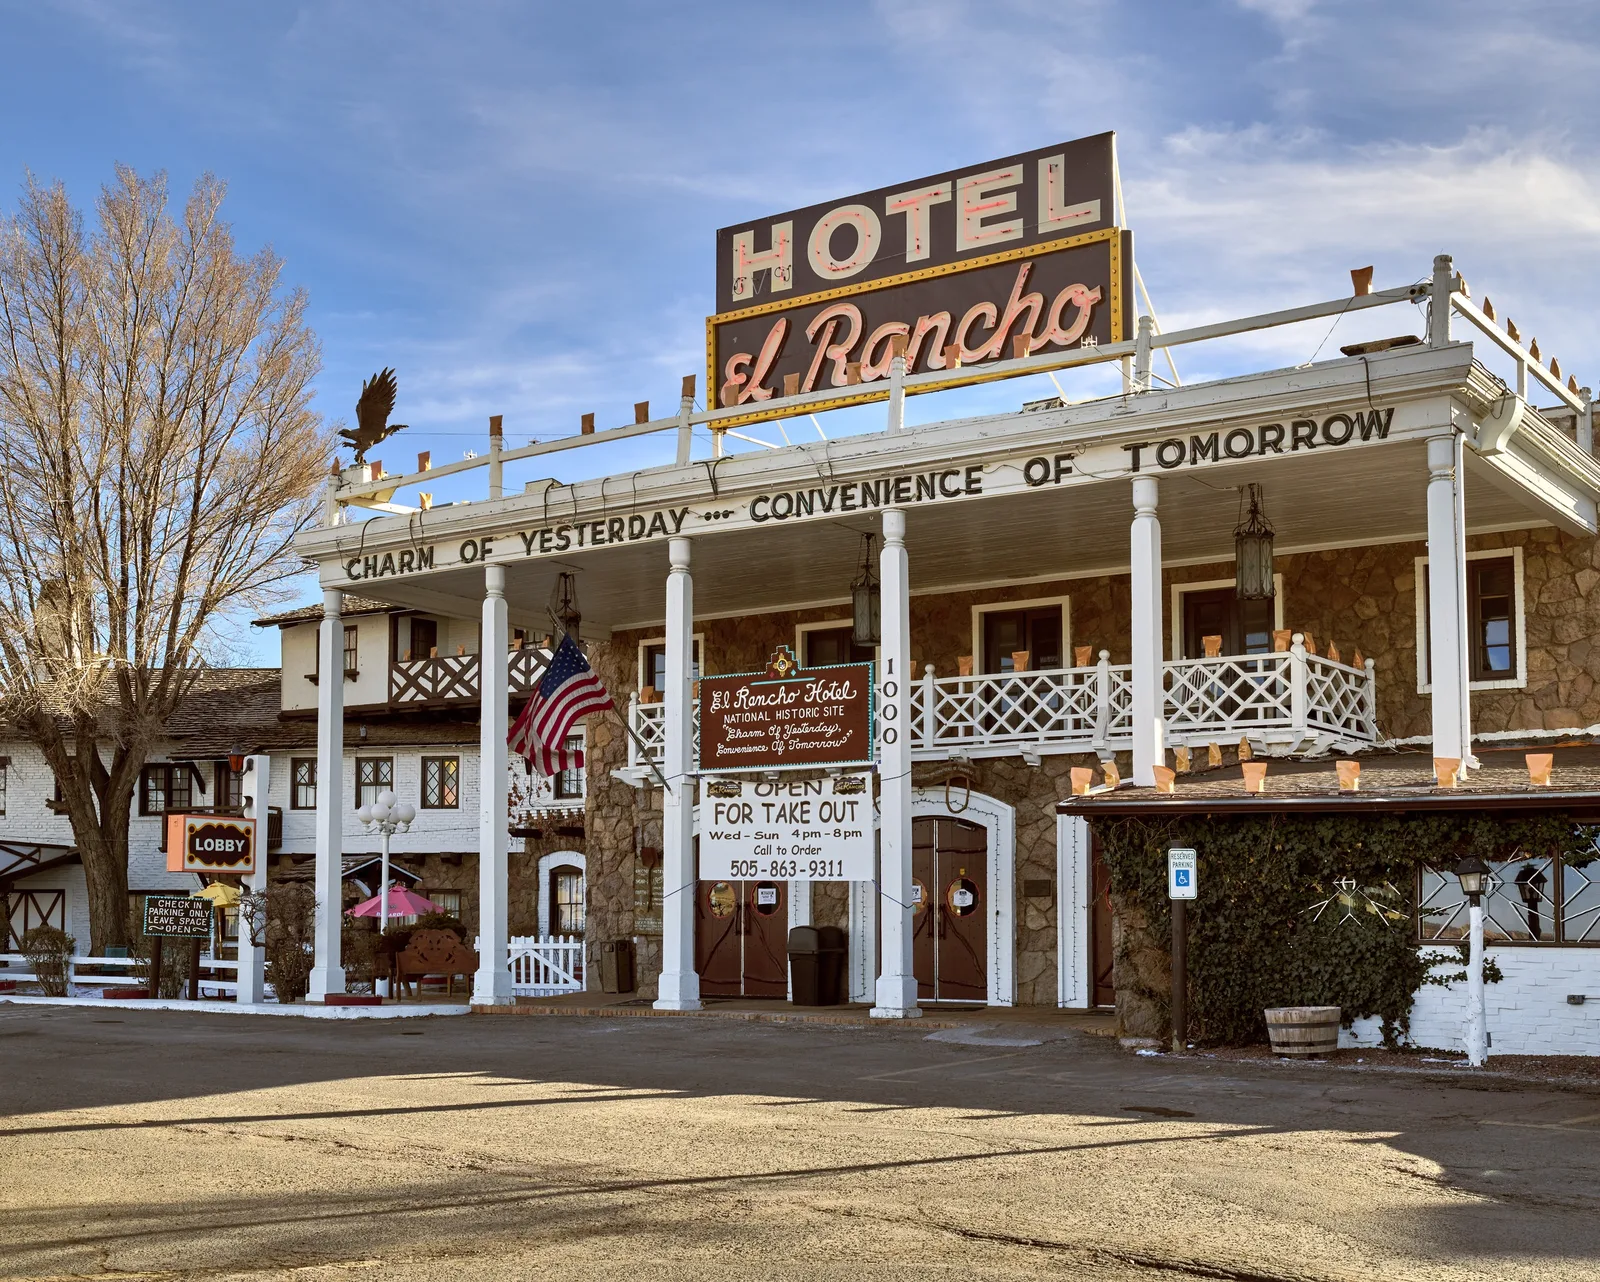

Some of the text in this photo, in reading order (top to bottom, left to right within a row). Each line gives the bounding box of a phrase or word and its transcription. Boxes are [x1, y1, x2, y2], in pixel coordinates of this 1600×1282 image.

[732, 154, 1101, 302] HOTEL
[801, 262, 1102, 393] Rancho
[346, 545, 435, 580] CHARM
[460, 537, 494, 564] OF
[520, 507, 688, 556] YESTERDAY
[750, 465, 984, 522] CONVENIENCE
[1023, 453, 1074, 487] OF
[1122, 408, 1395, 472] TOMORROW
[710, 679, 858, 714] El Rancho Hotel
[882, 658, 899, 745] 1000
[723, 705, 845, 724] NATIONAL HISTORIC SITE
[768, 724, 782, 740] Of
[784, 722, 842, 740] Yesterday,
[716, 742, 768, 757] Convenience
[771, 740, 786, 755] Of
[754, 780, 823, 797] OPEN
[714, 800, 859, 826] FOR TAKE OUT
[709, 831, 741, 841] Wed
[754, 831, 780, 841] Sun
[195, 838, 246, 852] LOBBY
[753, 845, 822, 856] Call to Order
[730, 860, 844, 878] 505-863-9311
[149, 908, 210, 918] PARKING ONLY
[158, 900, 203, 909] CHECK IN
[148, 916, 207, 926] LEAVE SPACE
[165, 925, 191, 933] OPEN
